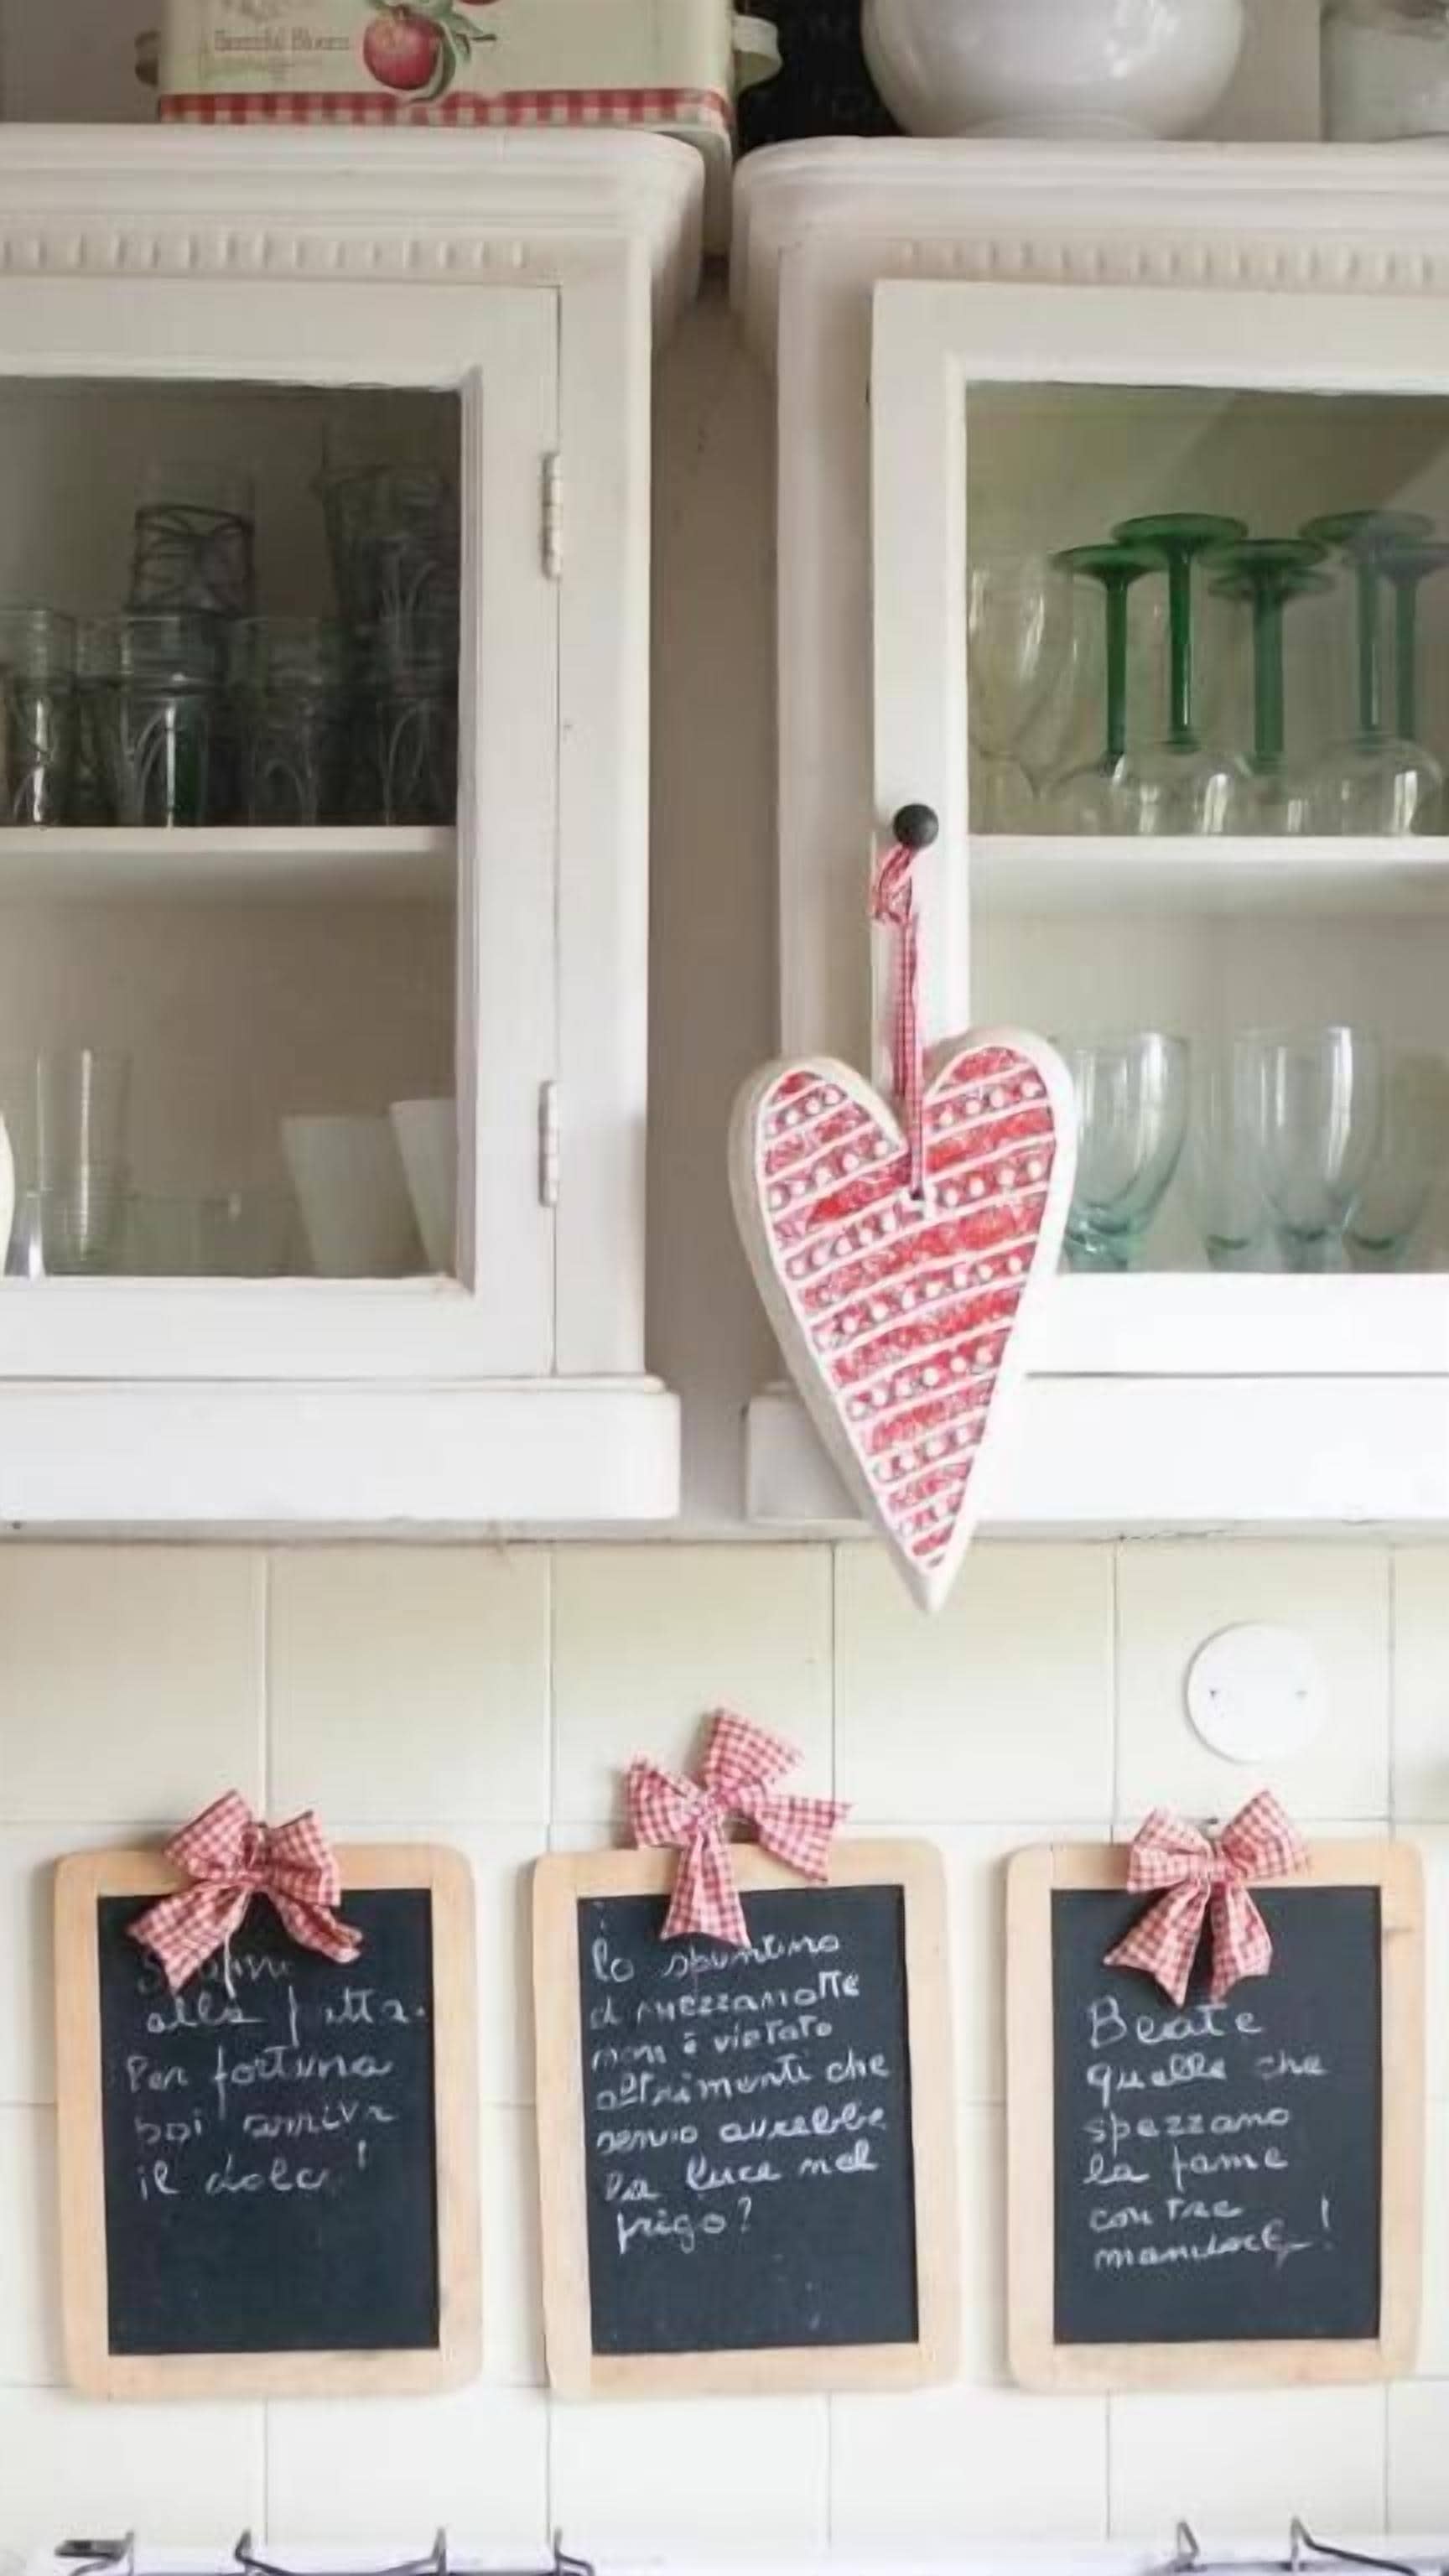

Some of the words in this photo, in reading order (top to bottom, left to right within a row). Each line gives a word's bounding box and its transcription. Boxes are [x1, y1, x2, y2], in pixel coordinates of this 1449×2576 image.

[713, 2014, 833, 2054] vietato
[1089, 1995, 1264, 2049] Beate
[214, 2044, 394, 2121] fortuna
[825, 2044, 891, 2084] che
[1254, 2049, 1330, 2081] che
[1083, 2106, 1291, 2158] spezzano
[685, 2147, 782, 2191] luce
[798, 2137, 879, 2177] nel
[1083, 2153, 1150, 2184] la
[1171, 2142, 1289, 2193] fame
